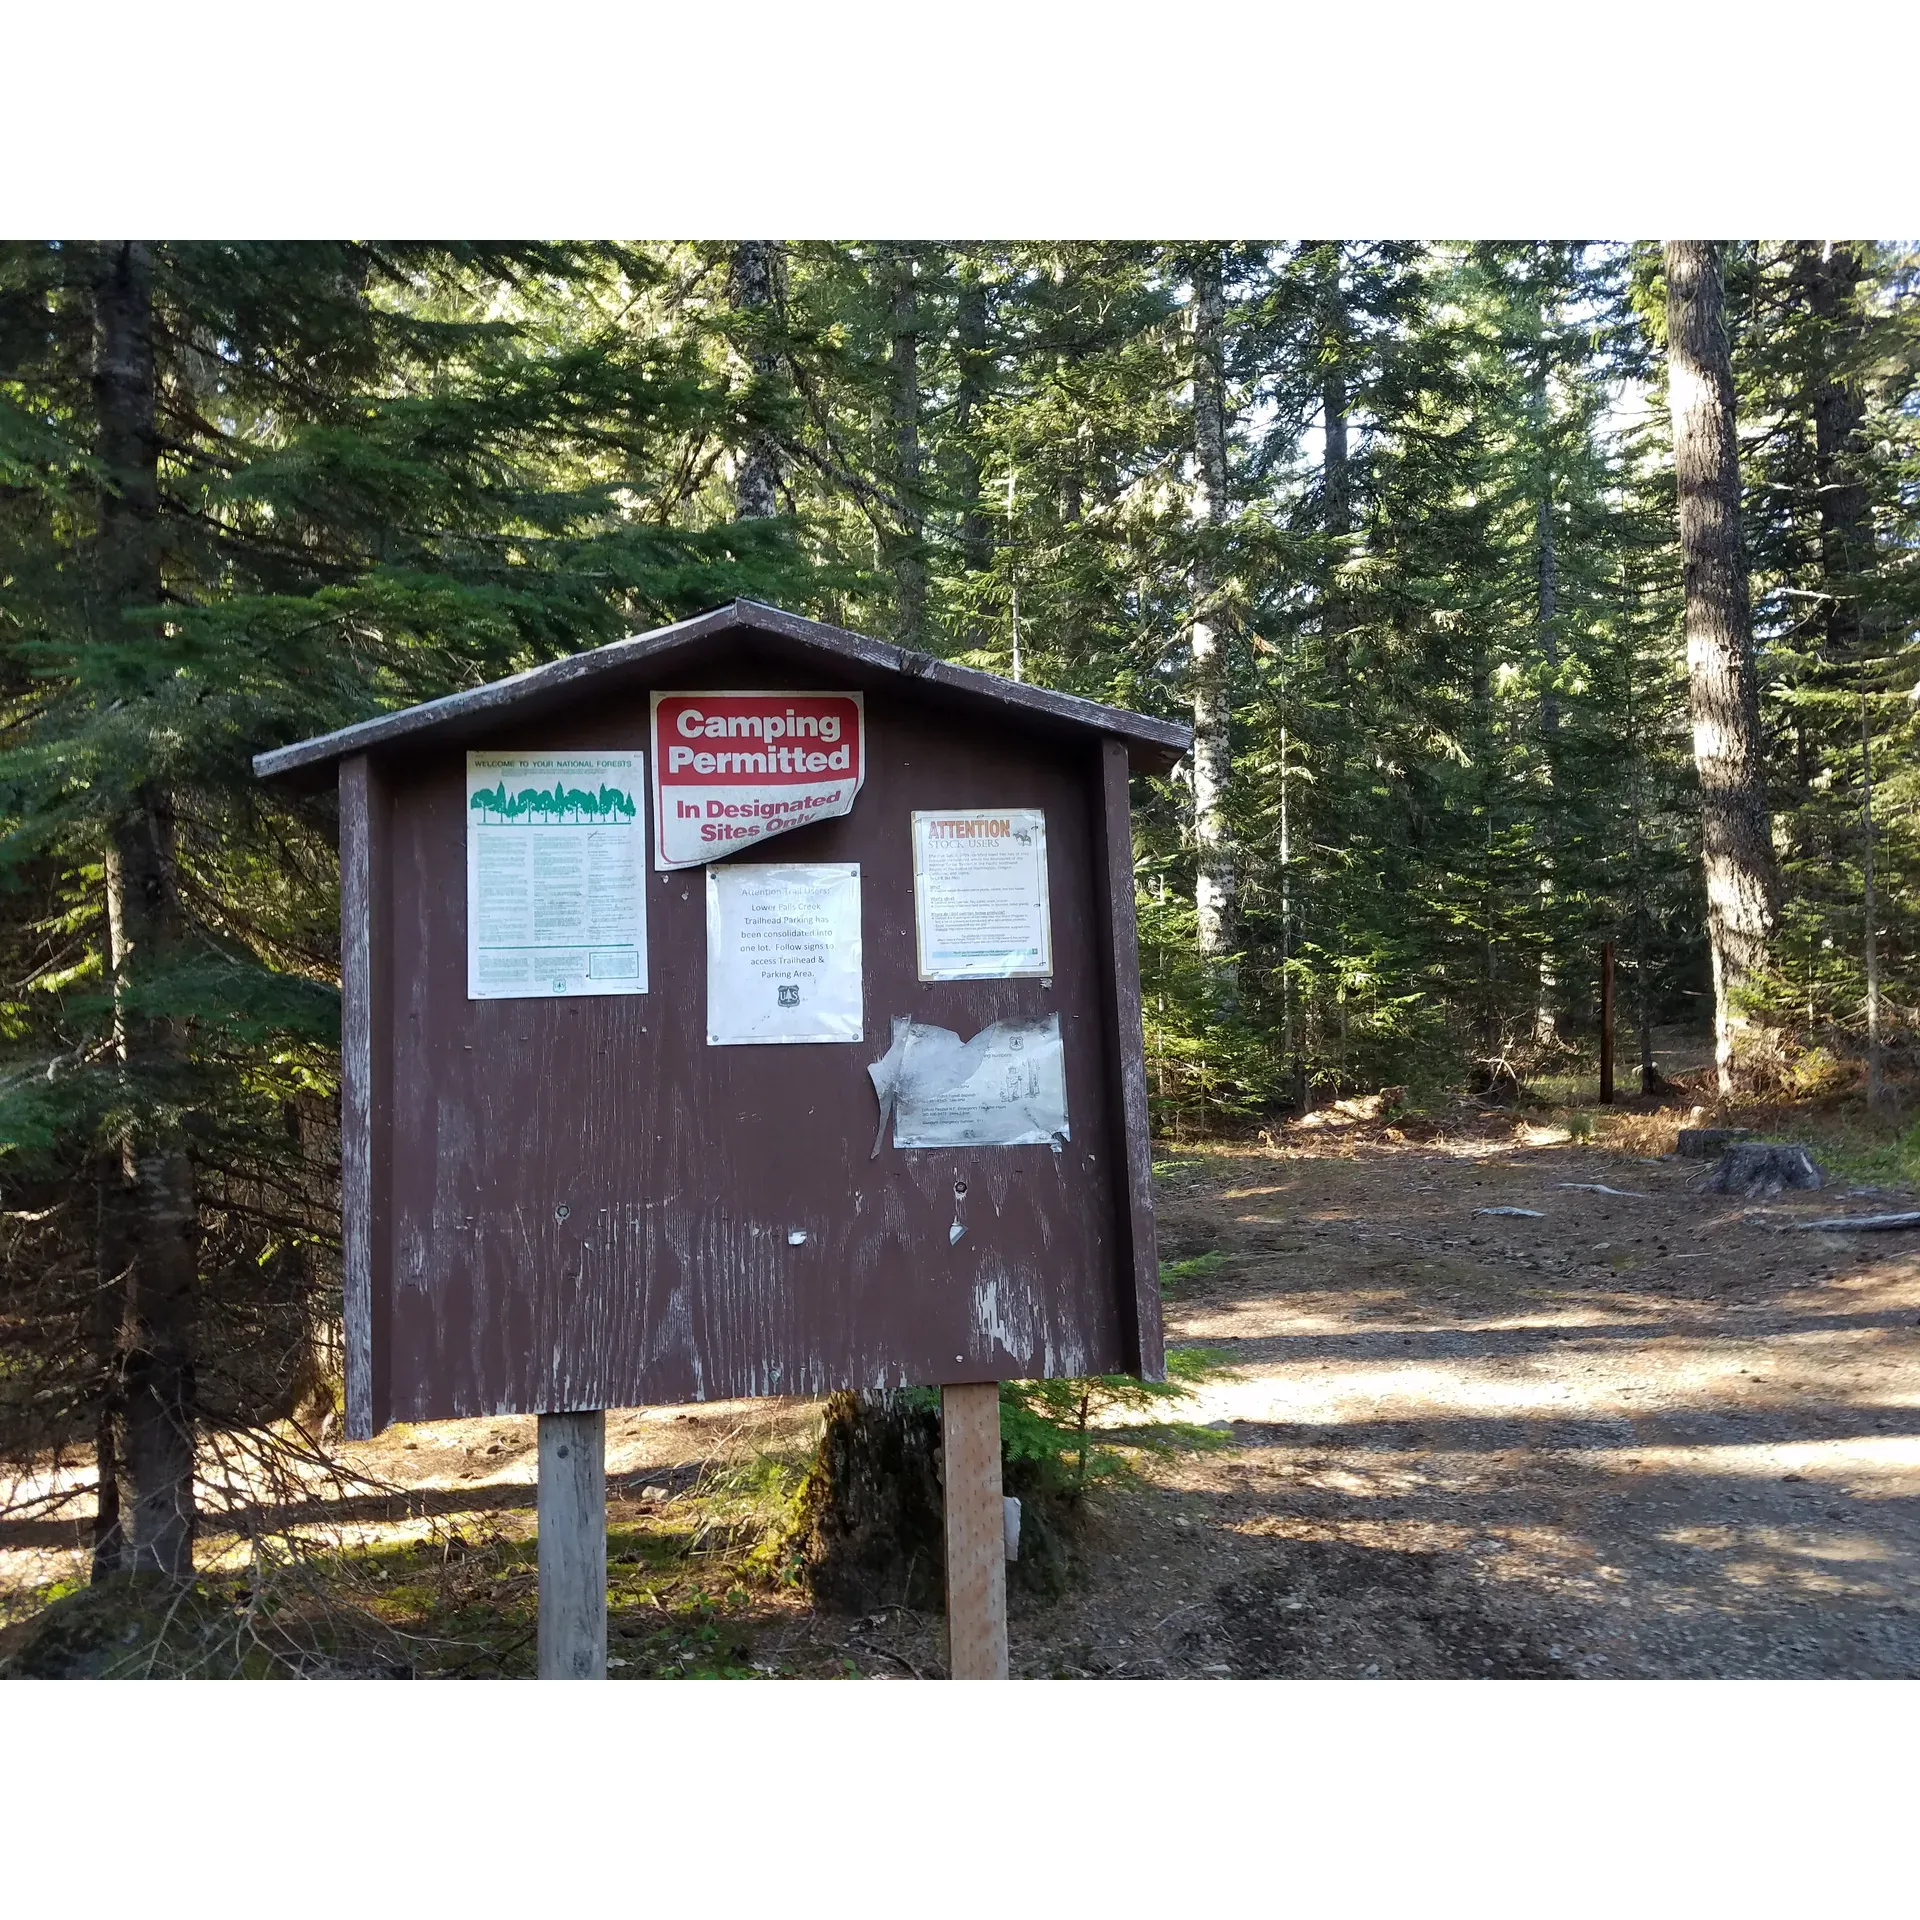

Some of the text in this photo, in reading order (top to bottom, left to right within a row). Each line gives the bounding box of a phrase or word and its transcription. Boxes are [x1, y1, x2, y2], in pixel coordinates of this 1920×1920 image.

[677, 708, 840, 743] Camping
[668, 744, 850, 774] Permitted
[677, 790, 841, 819] In Designated
[700, 812, 816, 842] Sites Only
[929, 820, 1010, 839] ATTENTION
[928, 839, 999, 849] STOCK USERS
[784, 917, 813, 925] Parking
[778, 956, 816, 964] Trailhead
[761, 971, 791, 979] Parking
